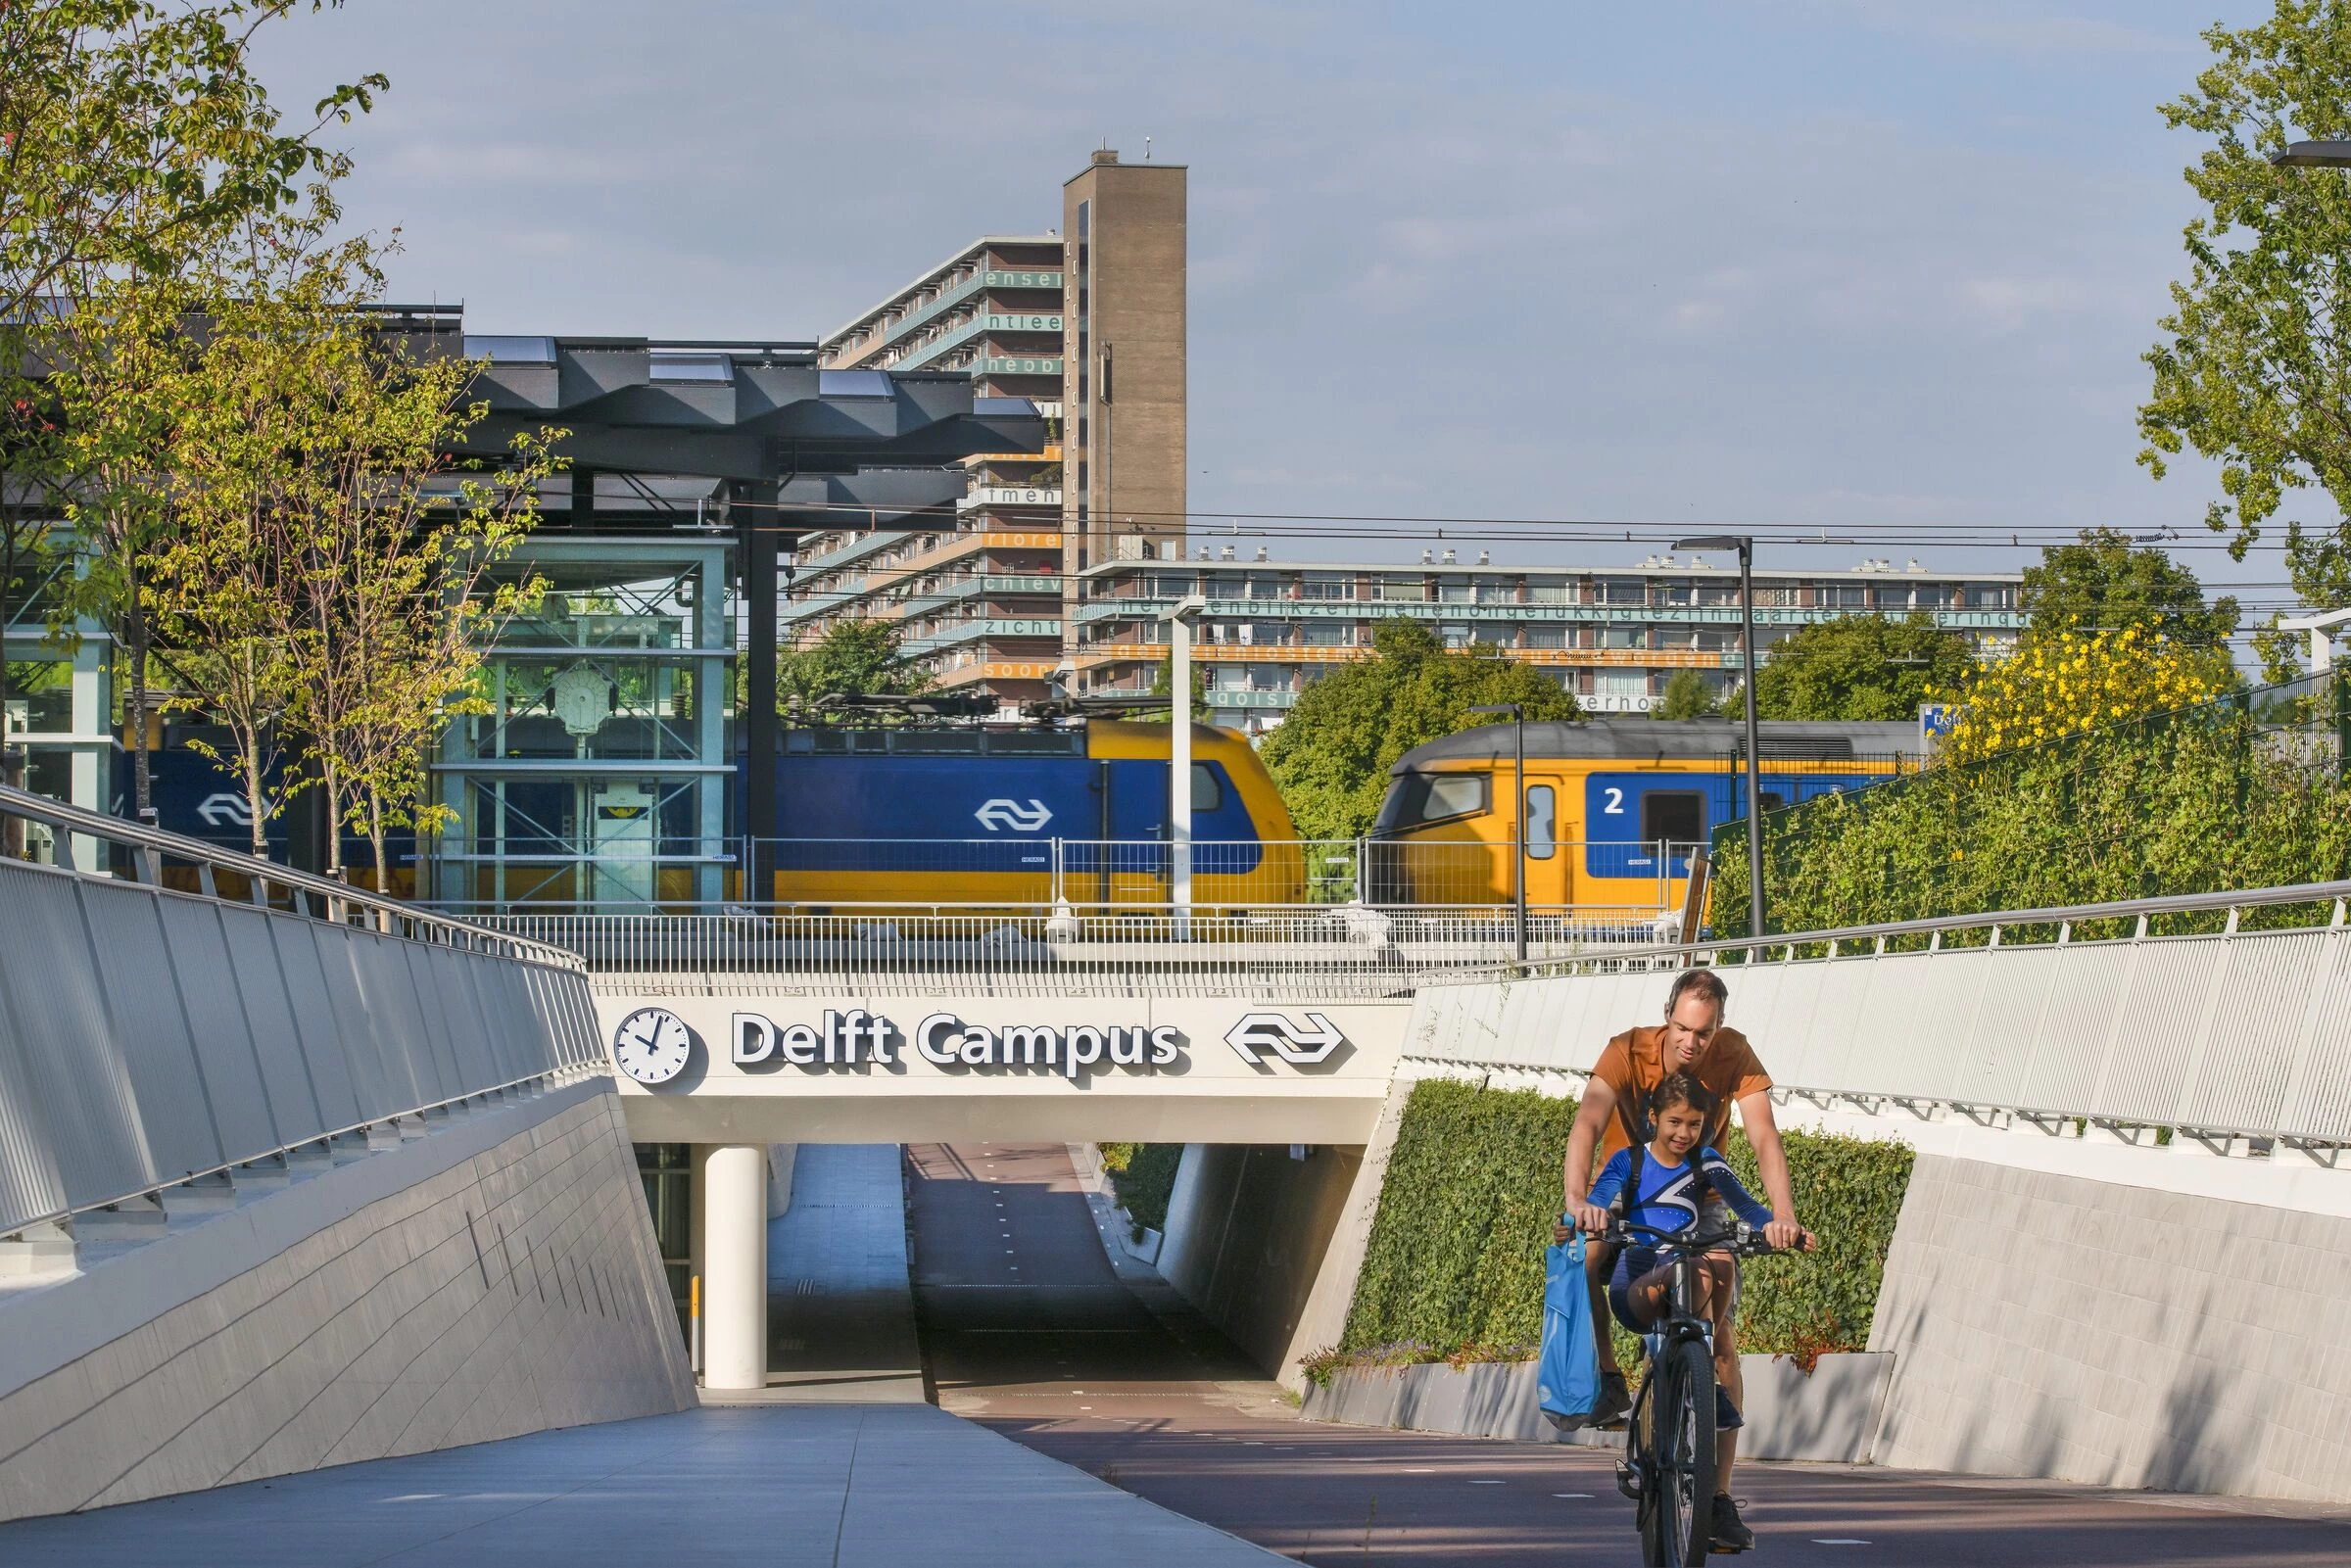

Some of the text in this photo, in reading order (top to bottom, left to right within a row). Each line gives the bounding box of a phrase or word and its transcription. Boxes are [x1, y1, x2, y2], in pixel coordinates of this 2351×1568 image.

[984, 620, 1056, 635] zicht
[1604, 787, 1624, 814] 2
[732, 1009, 1179, 1078] Delft Campus
